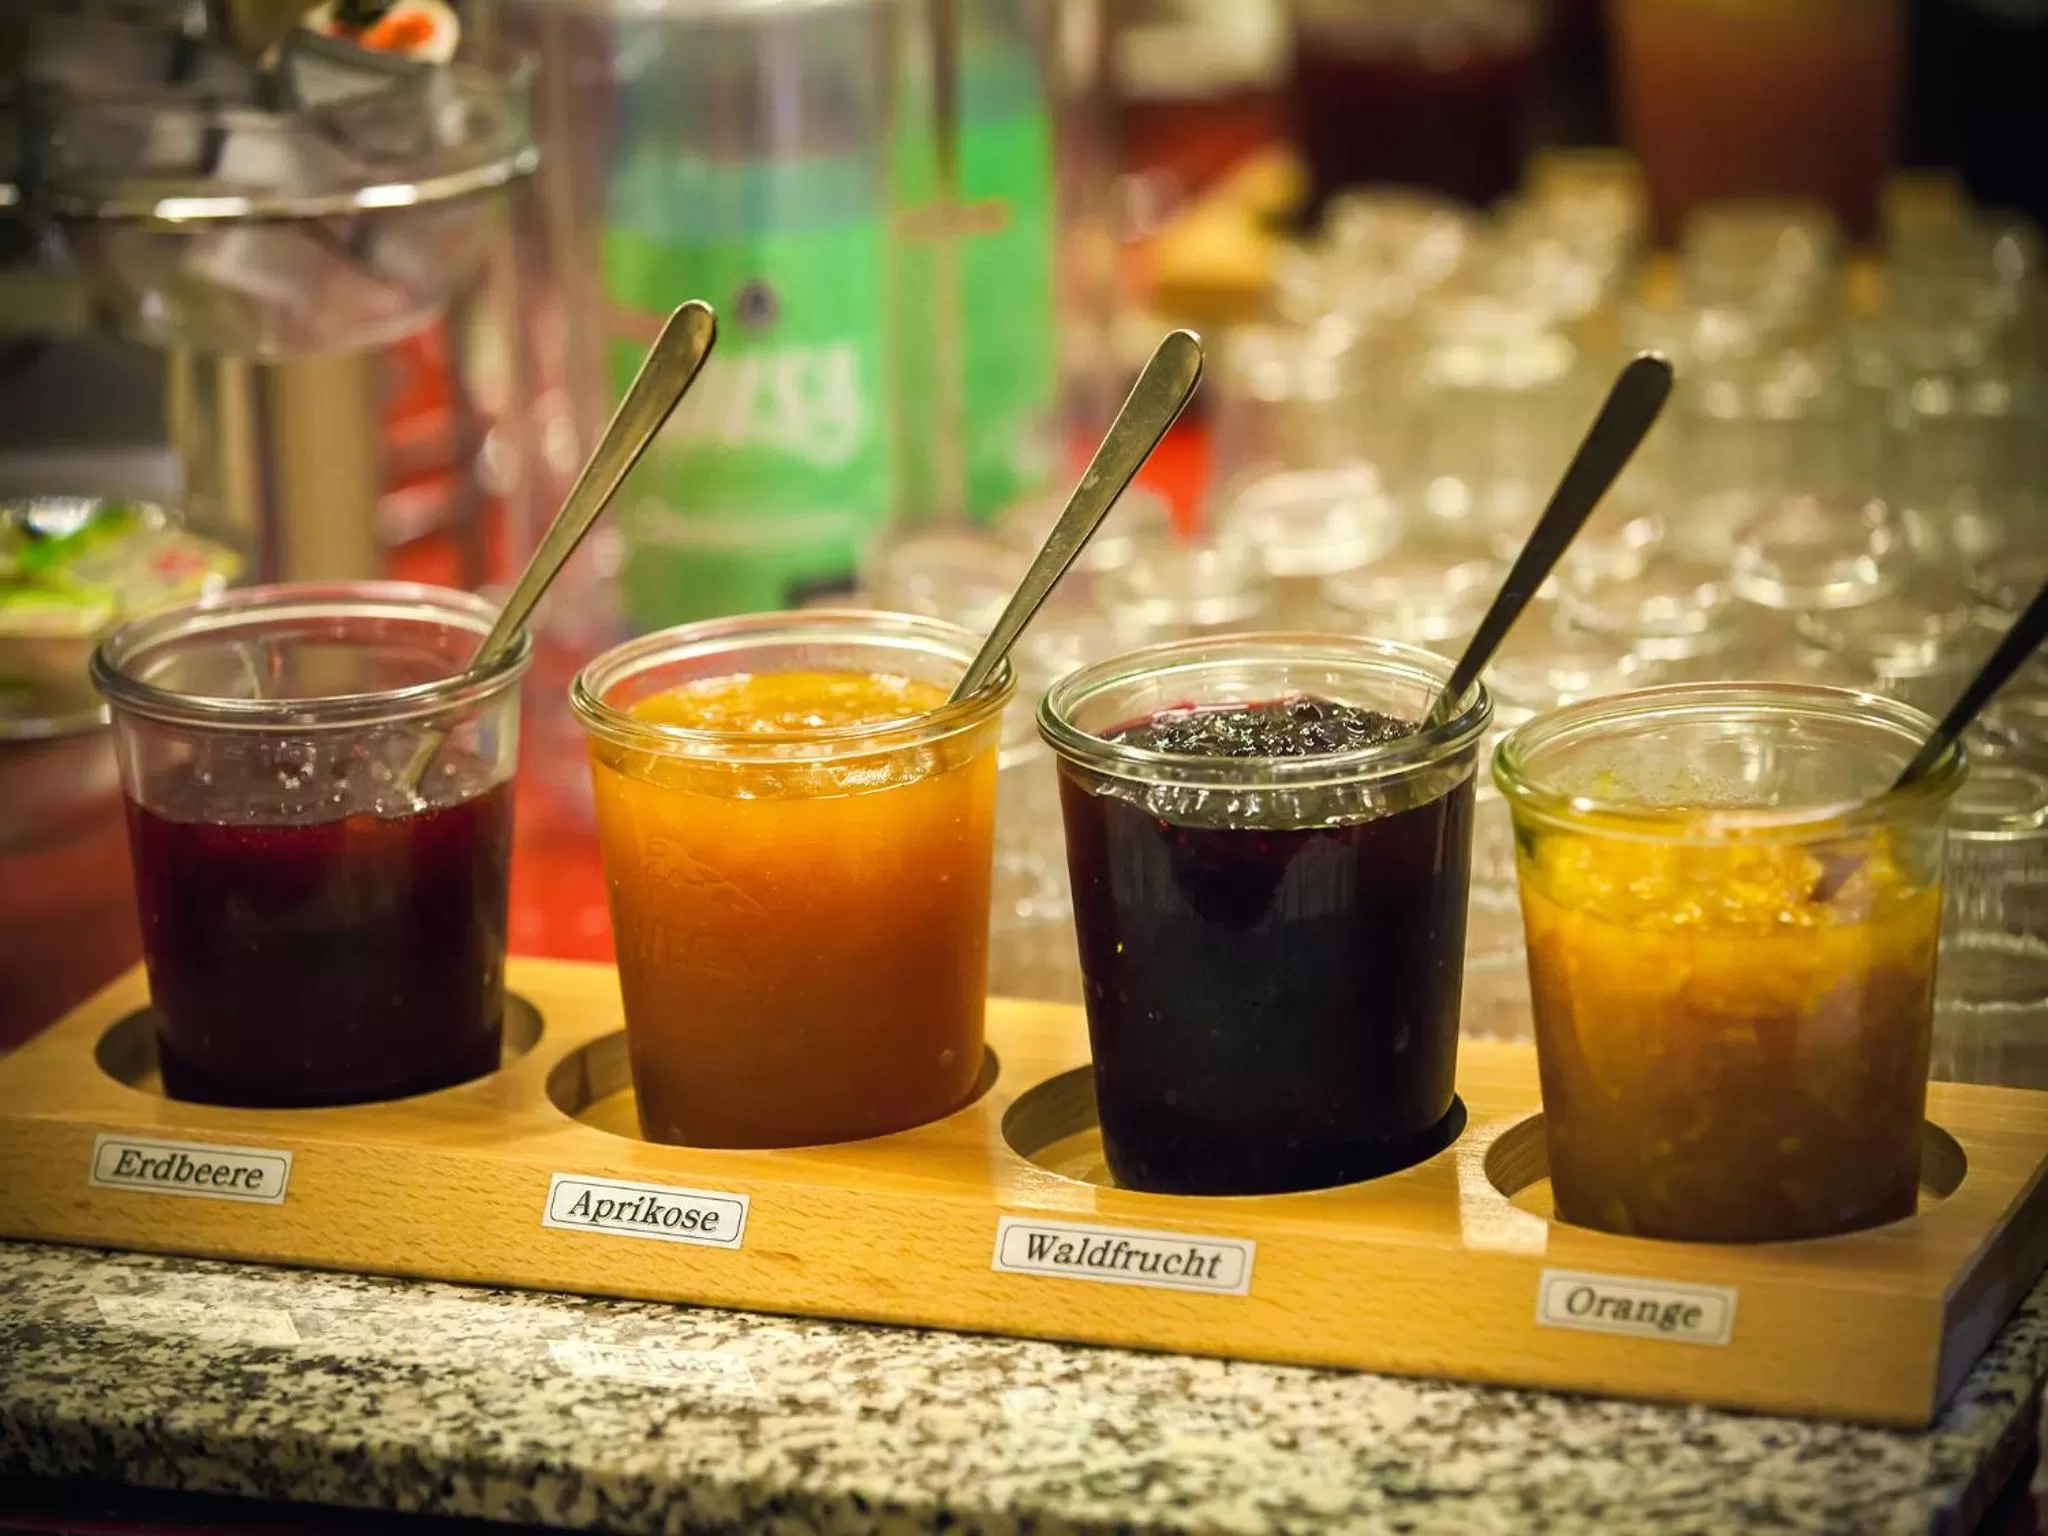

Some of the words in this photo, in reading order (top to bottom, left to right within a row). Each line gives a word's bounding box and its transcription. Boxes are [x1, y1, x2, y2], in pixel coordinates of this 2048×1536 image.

[112, 1149, 264, 1190] Erdbeere
[567, 1190, 720, 1232] Aprikose
[1025, 1233, 1223, 1280] Waldfrucht
[1565, 1285, 1704, 1332] Orange
